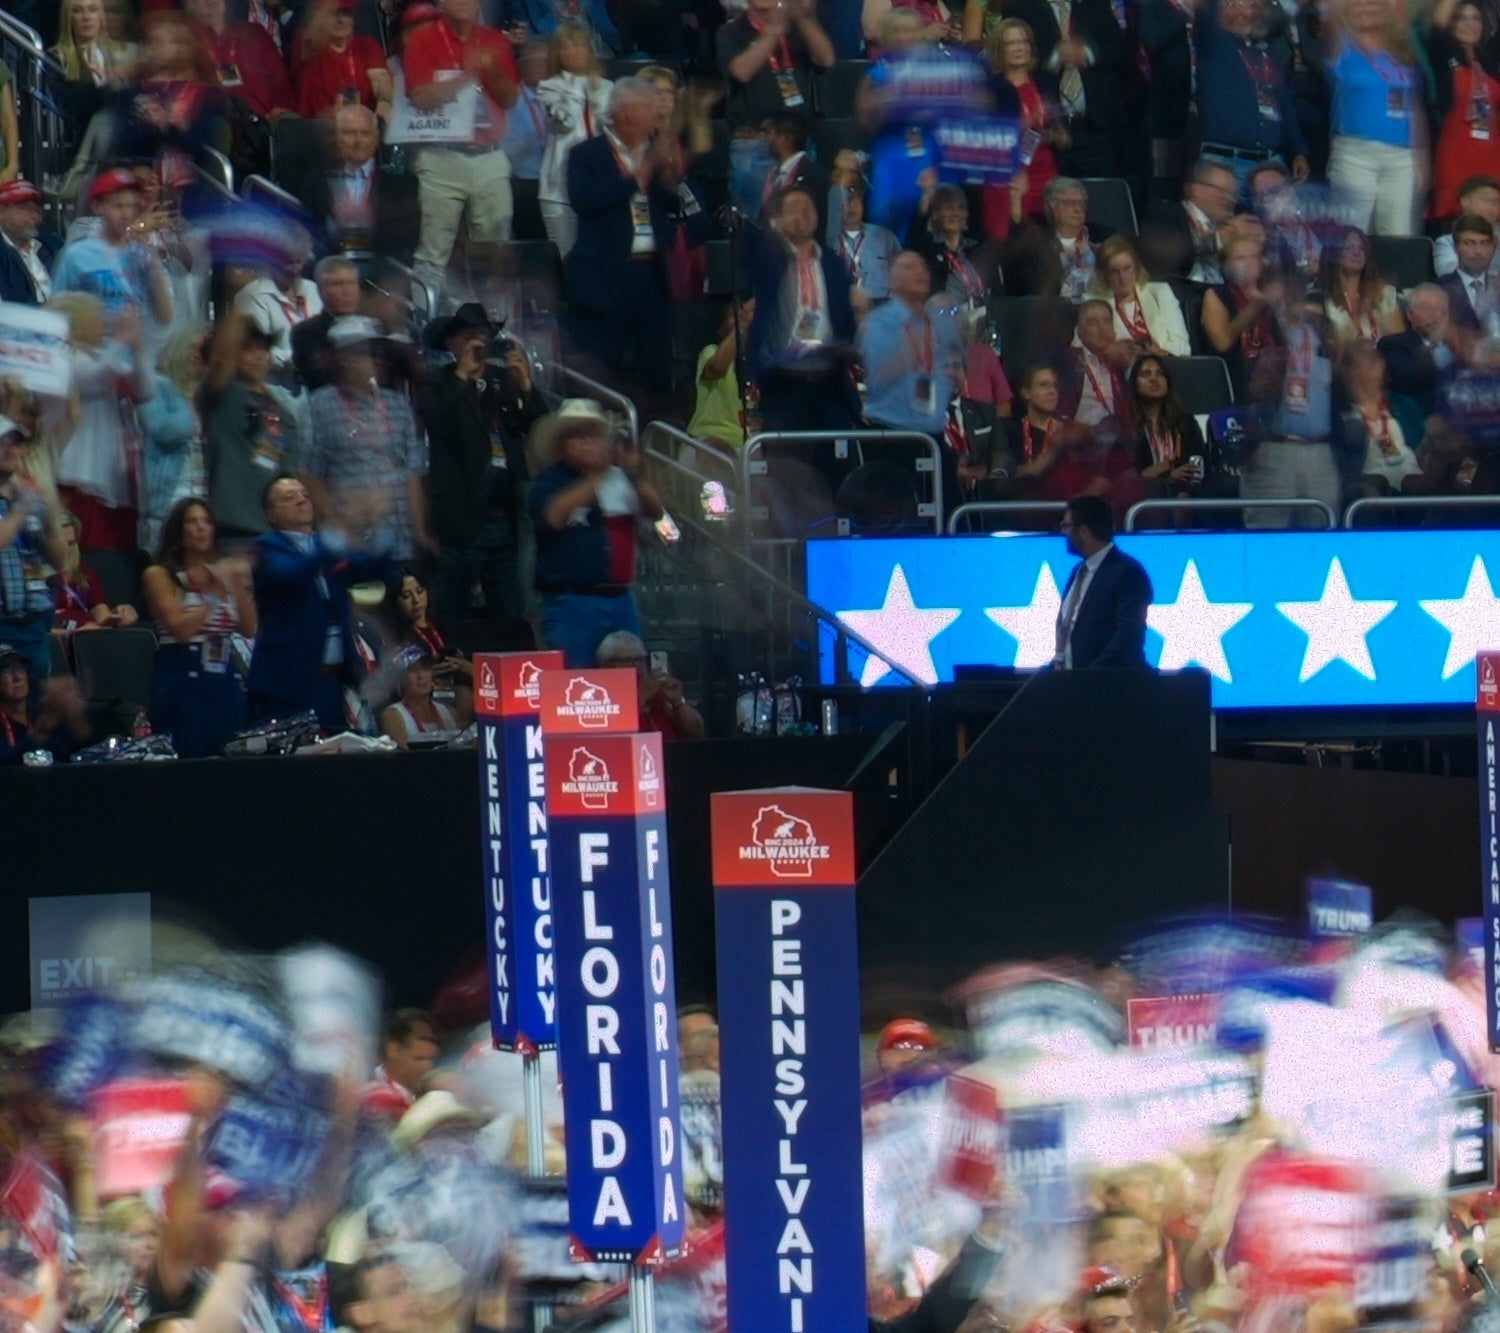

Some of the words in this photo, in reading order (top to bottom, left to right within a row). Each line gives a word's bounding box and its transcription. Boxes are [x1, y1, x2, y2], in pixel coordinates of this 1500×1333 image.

[406, 118, 452, 133] AGAIN!
[935, 126, 1020, 152] TRUMP
[562, 781, 618, 795] MILWAUKEE
[1486, 719, 1500, 905] AMERICAN
[740, 846, 830, 860] MILWAUKEE
[485, 726, 509, 1025] KENTUCKY
[1315, 907, 1371, 933] TRUMP
[40, 957, 112, 985] EXIT
[579, 833, 632, 1226] FLORIDA
[646, 829, 678, 1224] FLORIDA
